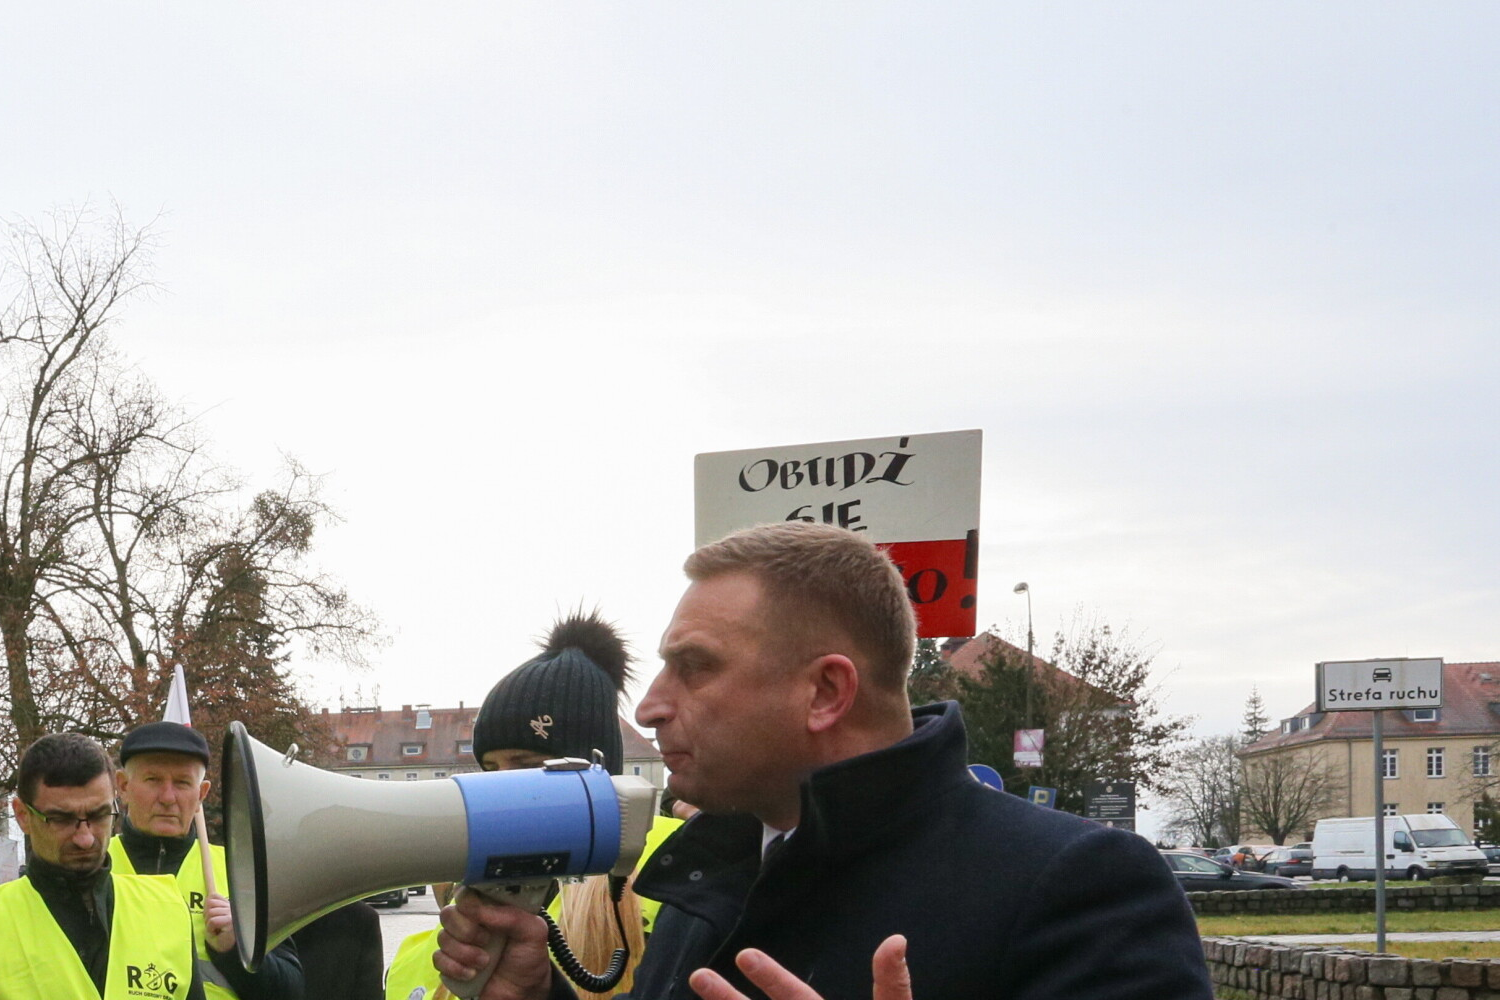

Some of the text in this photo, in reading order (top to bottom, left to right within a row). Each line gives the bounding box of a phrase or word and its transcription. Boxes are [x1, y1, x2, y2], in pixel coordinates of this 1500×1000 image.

[1328, 686, 1438, 702] Strefa ruchu
[1034, 789, 1050, 805] P
